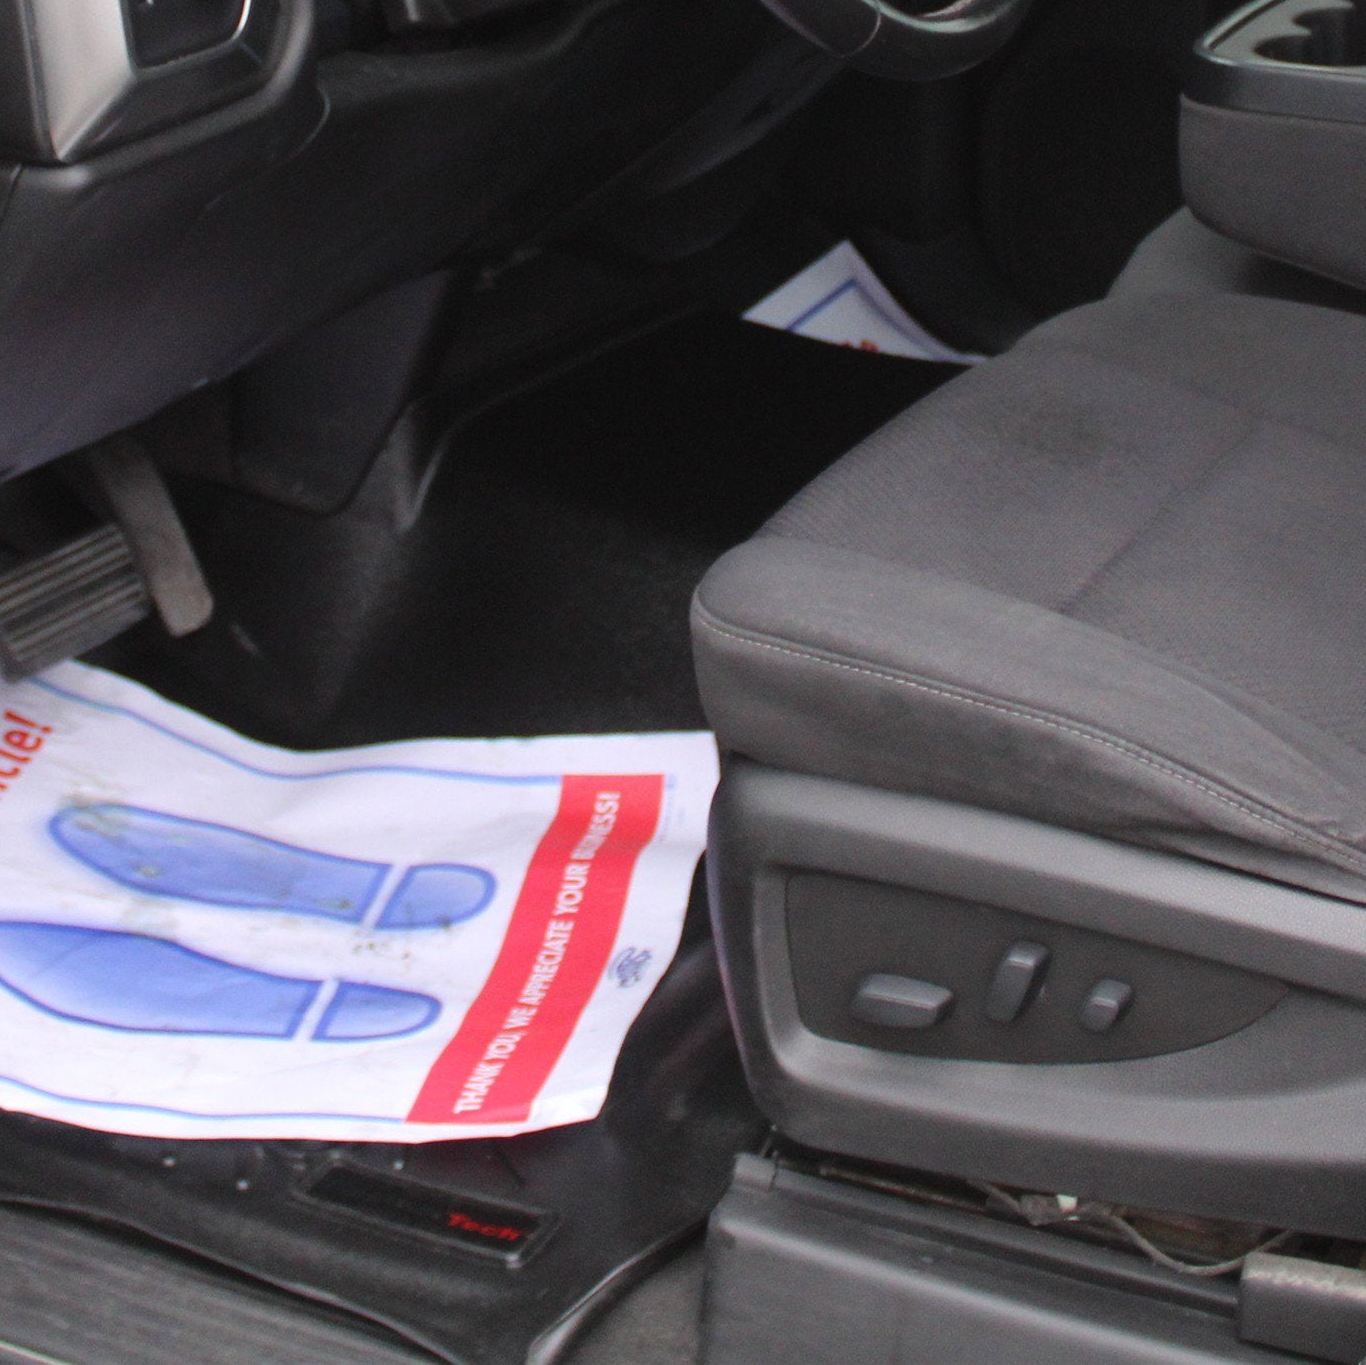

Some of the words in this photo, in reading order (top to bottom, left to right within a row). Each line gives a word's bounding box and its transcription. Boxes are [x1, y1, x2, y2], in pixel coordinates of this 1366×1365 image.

[570, 791, 621, 861] BNESS!
[552, 859, 591, 915] YOUR
[519, 919, 574, 1007] APPRECIATE
[503, 1007, 537, 1031] WE
[453, 1055, 504, 1114] THANK
